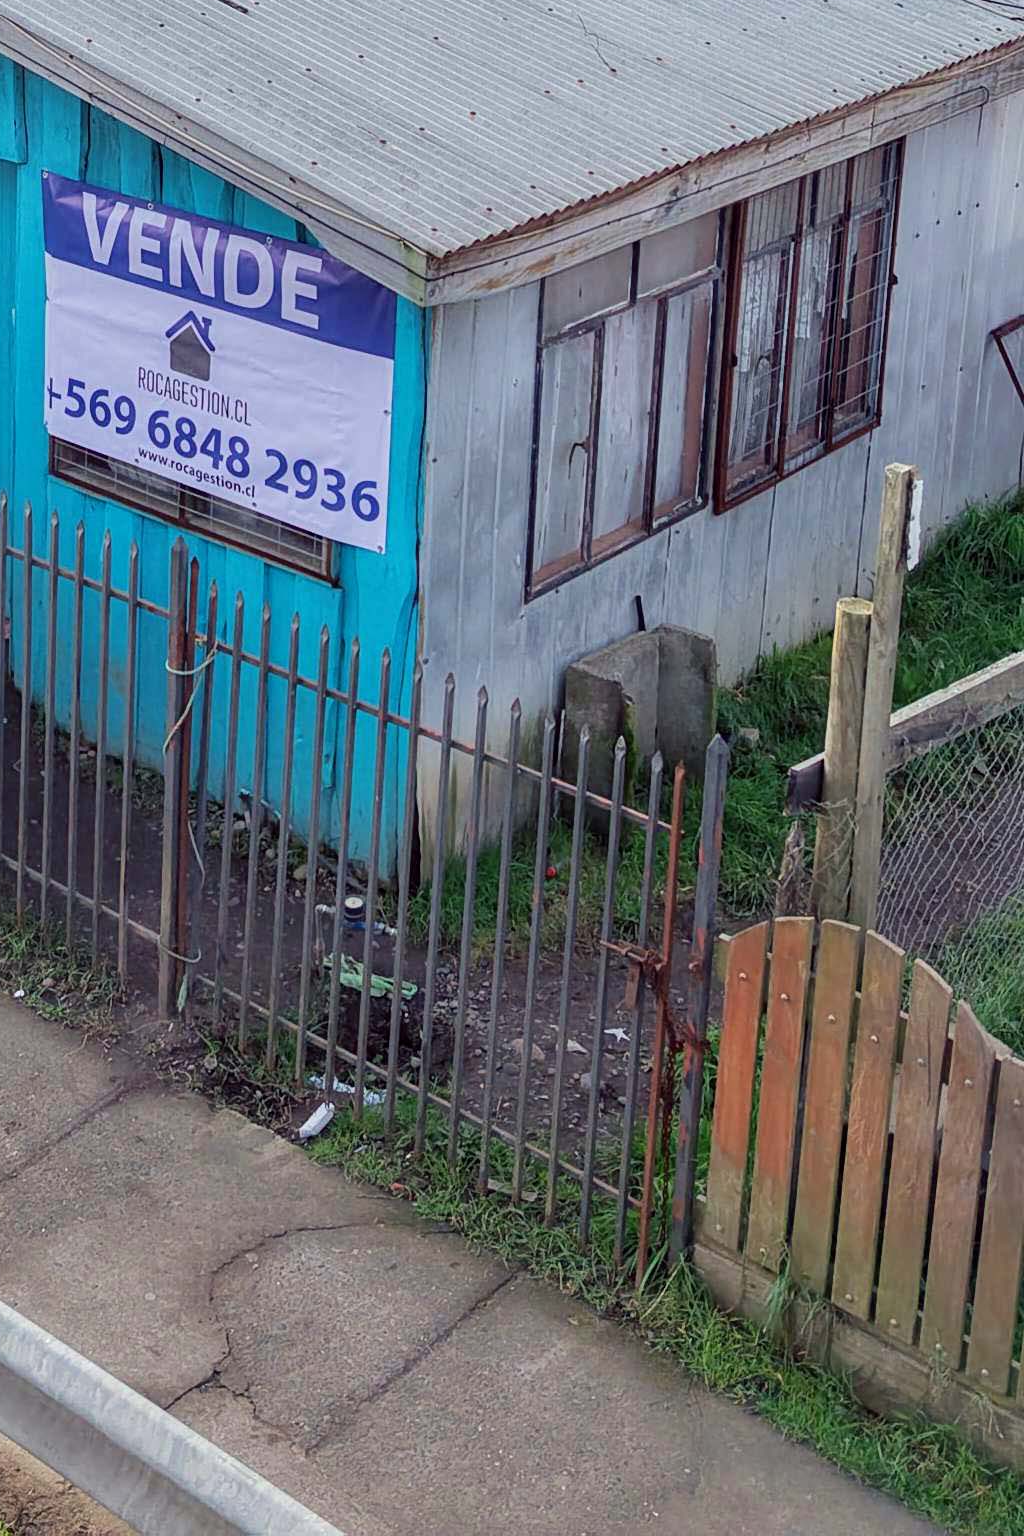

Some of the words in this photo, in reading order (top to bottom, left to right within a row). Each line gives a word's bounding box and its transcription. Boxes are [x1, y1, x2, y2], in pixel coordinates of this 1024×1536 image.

[82, 192, 323, 330] VENDE
[138, 366, 252, 426] ROCAGESTION.CL
[47, 377, 136, 435] +569
[147, 409, 250, 479] 6848
[264, 448, 381, 522] 2936
[138, 447, 256, 499] www.rocagestion.cl
